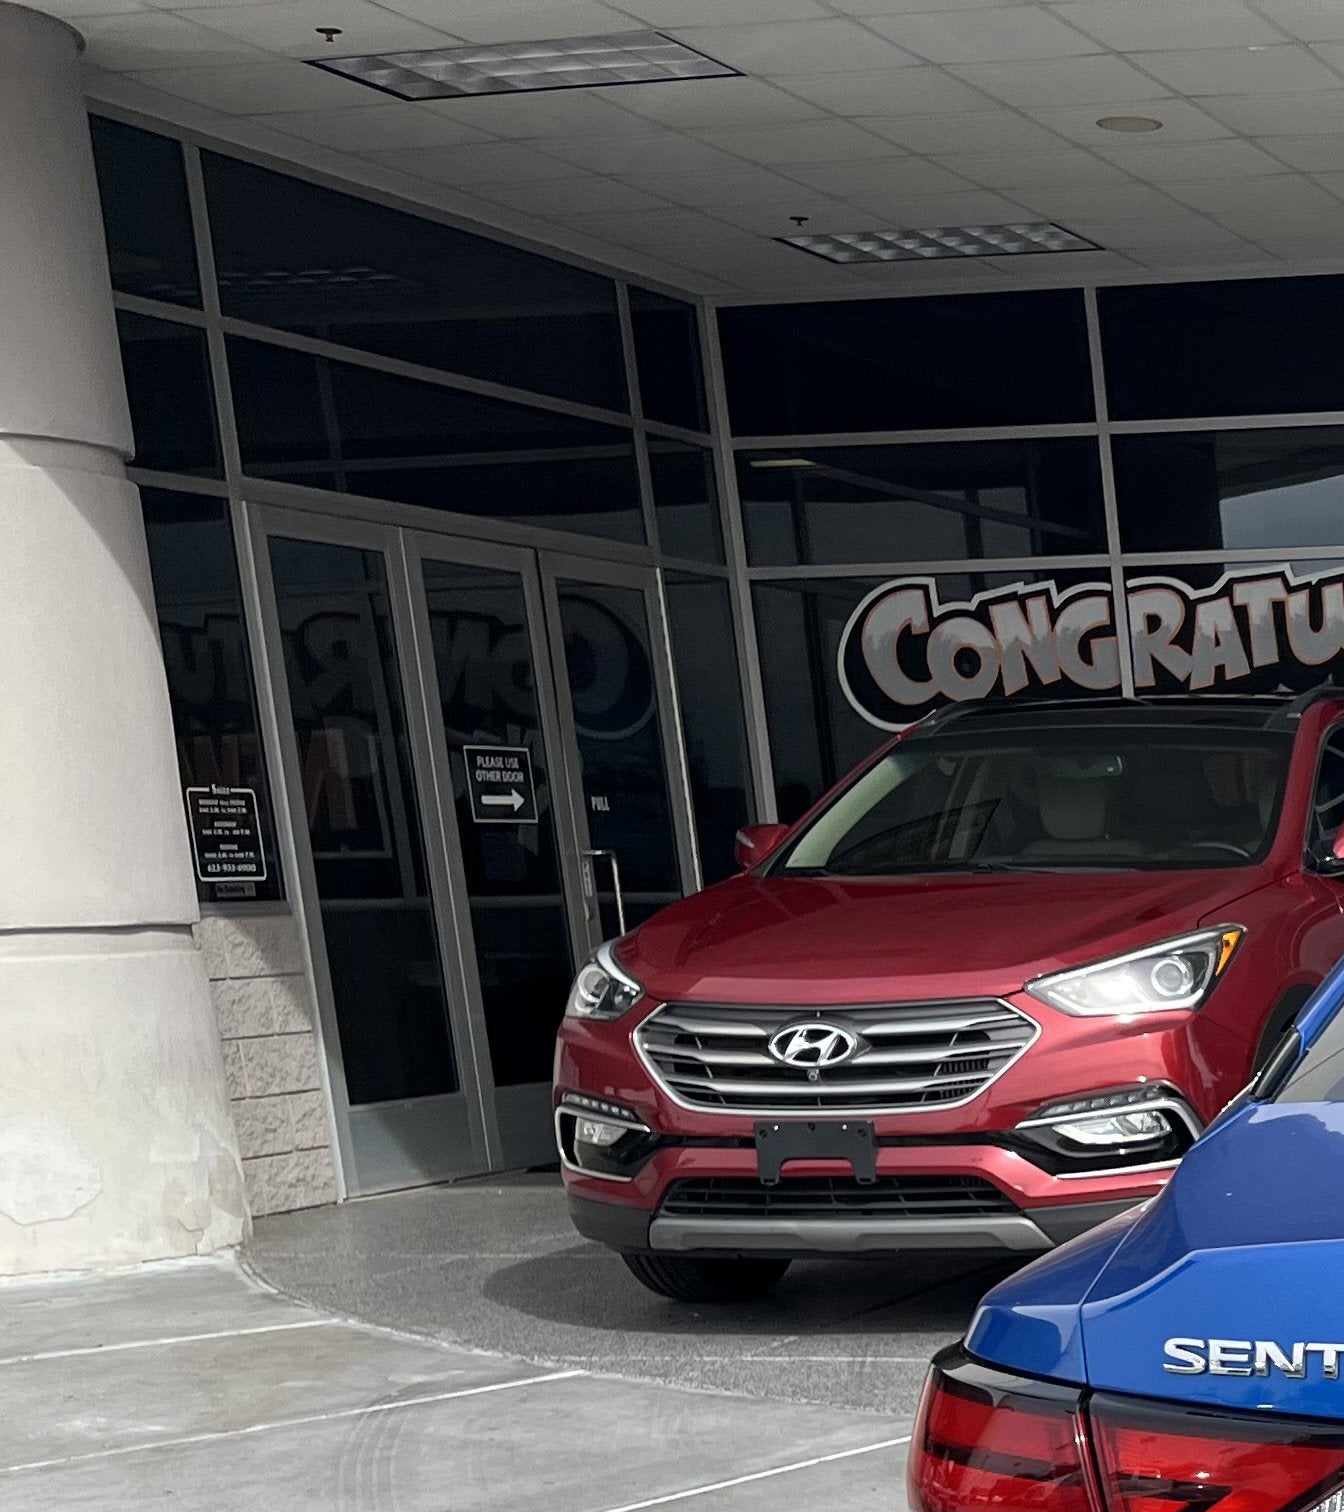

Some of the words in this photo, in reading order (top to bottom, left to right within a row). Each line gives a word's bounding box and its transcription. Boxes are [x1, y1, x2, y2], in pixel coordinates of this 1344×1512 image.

[476, 756, 504, 768] PLEASE
[505, 757, 519, 768] USE
[475, 770, 500, 782] OTHER
[502, 771, 525, 783] DOOR
[591, 796, 611, 811] PULL
